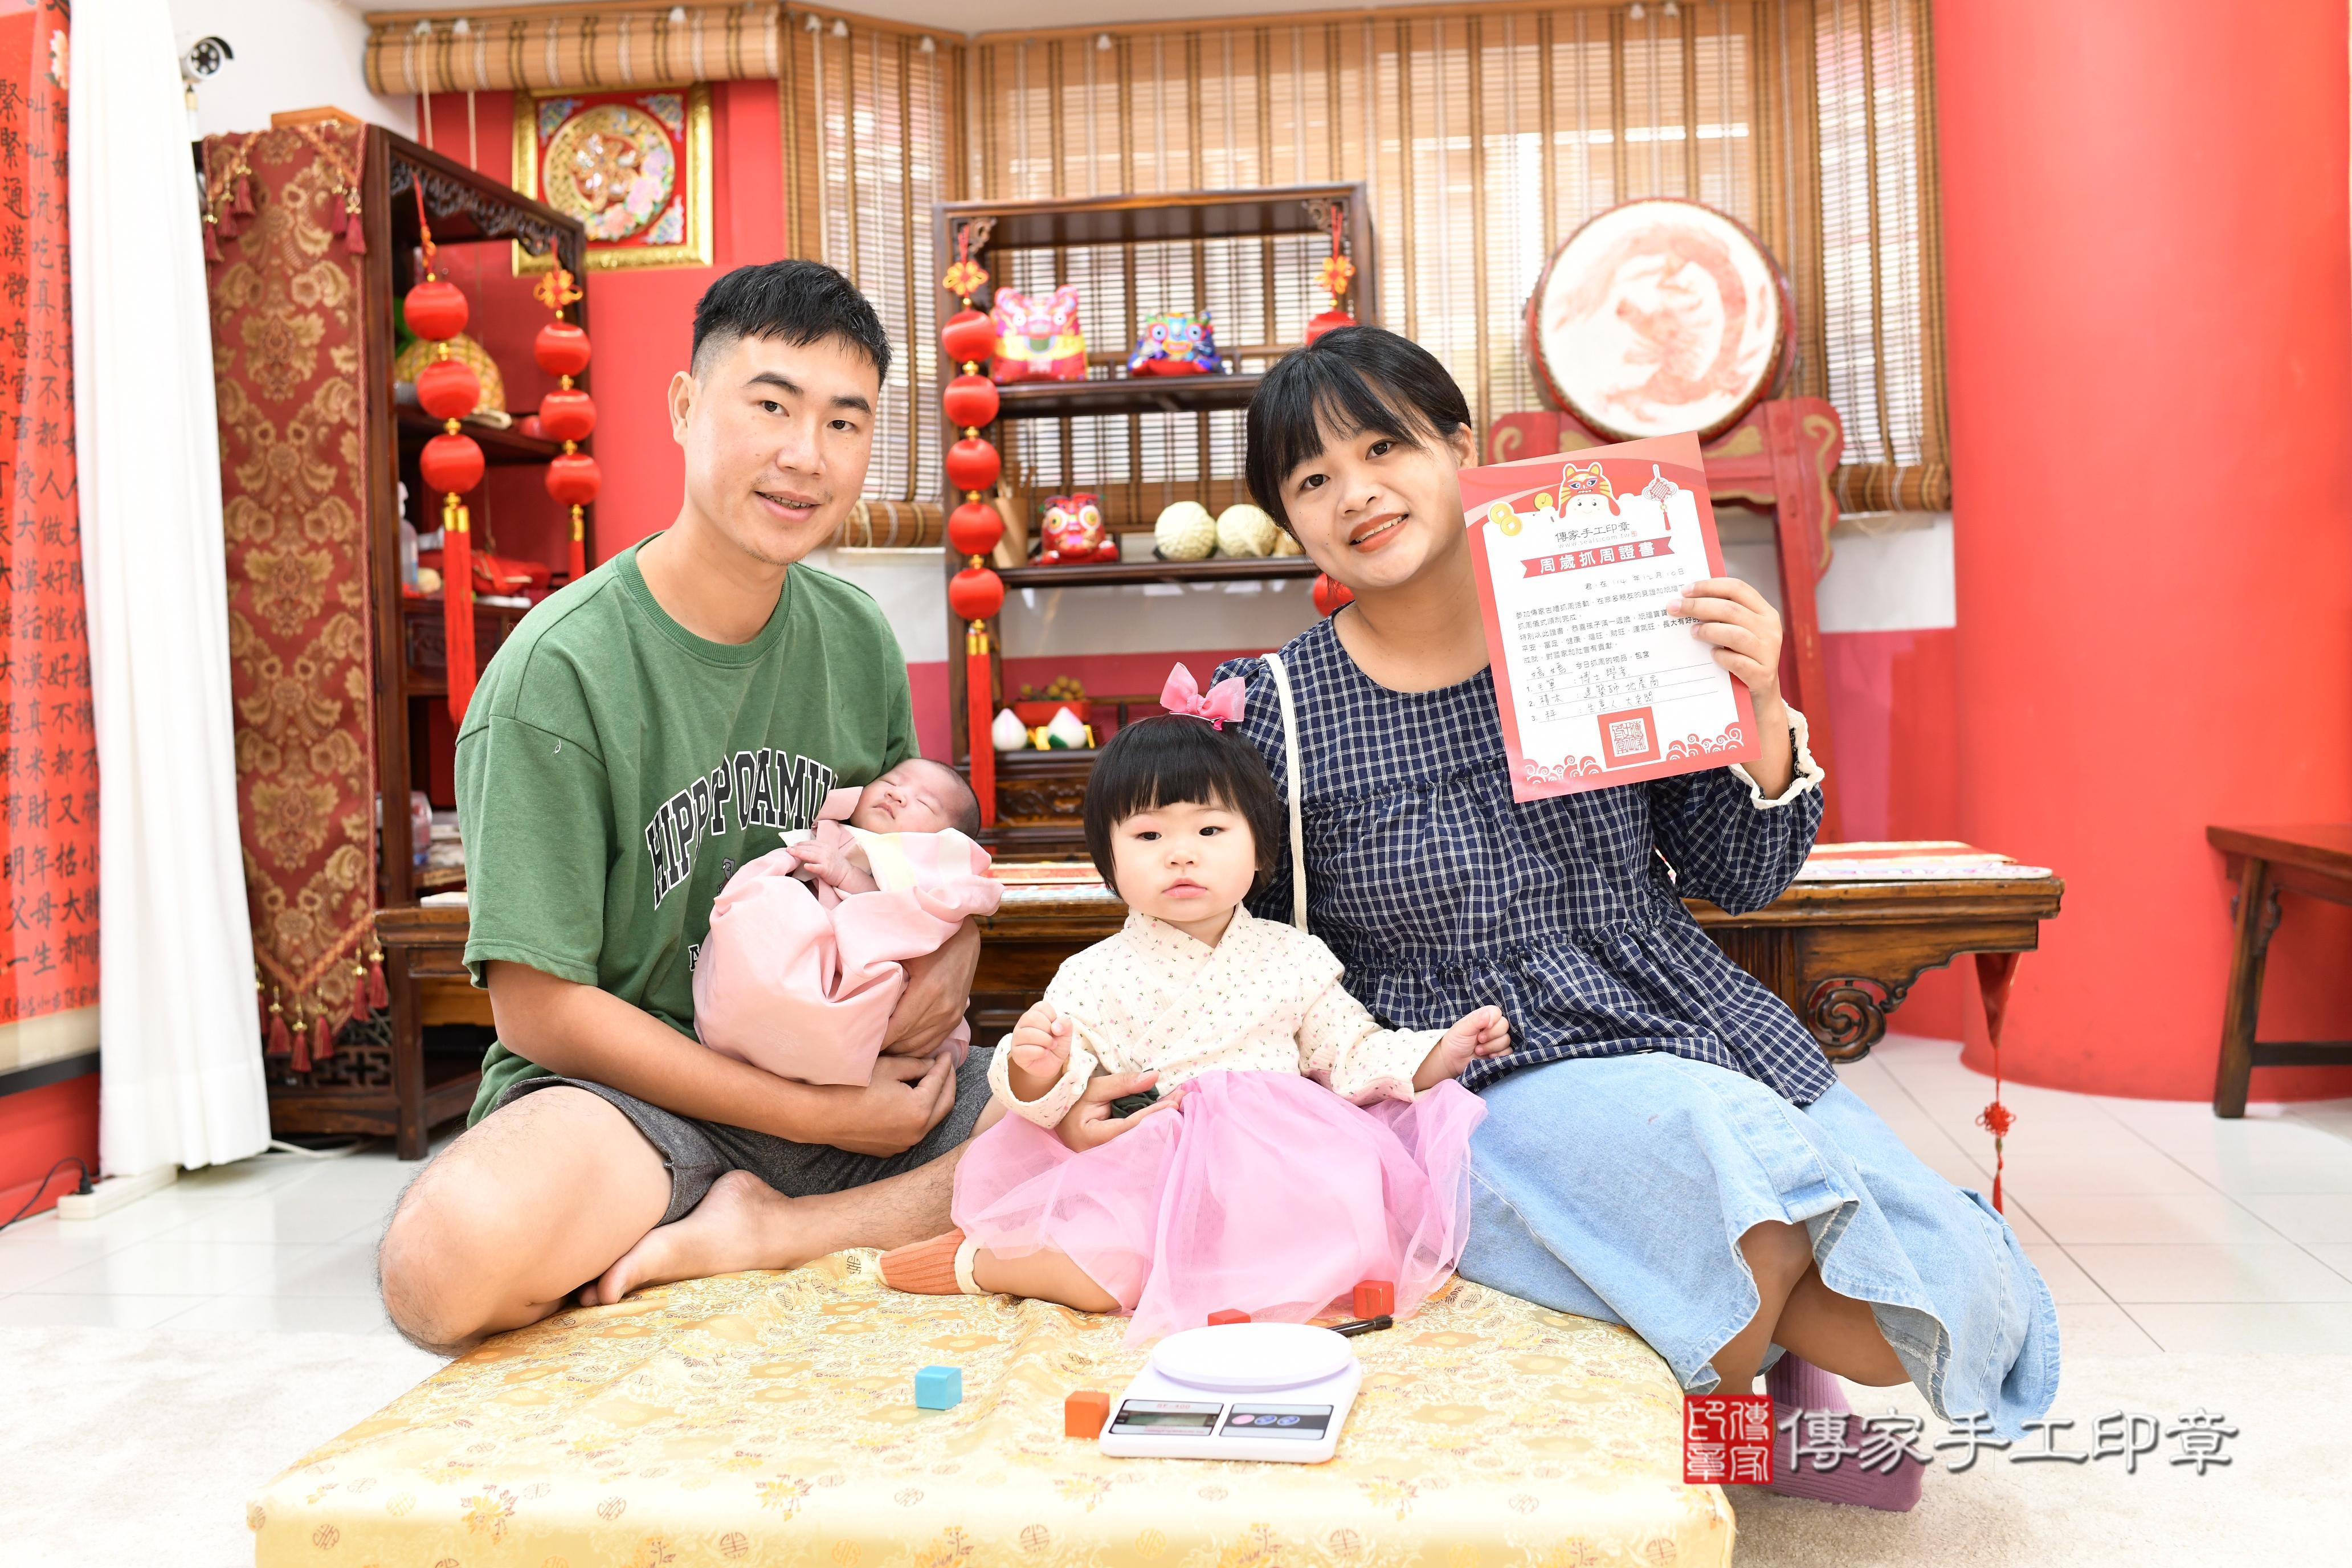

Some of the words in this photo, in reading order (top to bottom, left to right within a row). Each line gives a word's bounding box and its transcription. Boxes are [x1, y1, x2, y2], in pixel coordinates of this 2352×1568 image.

[1555, 521, 1630, 542] 傳家手工印章
[1540, 541, 1655, 574] 周歲抓周證書
